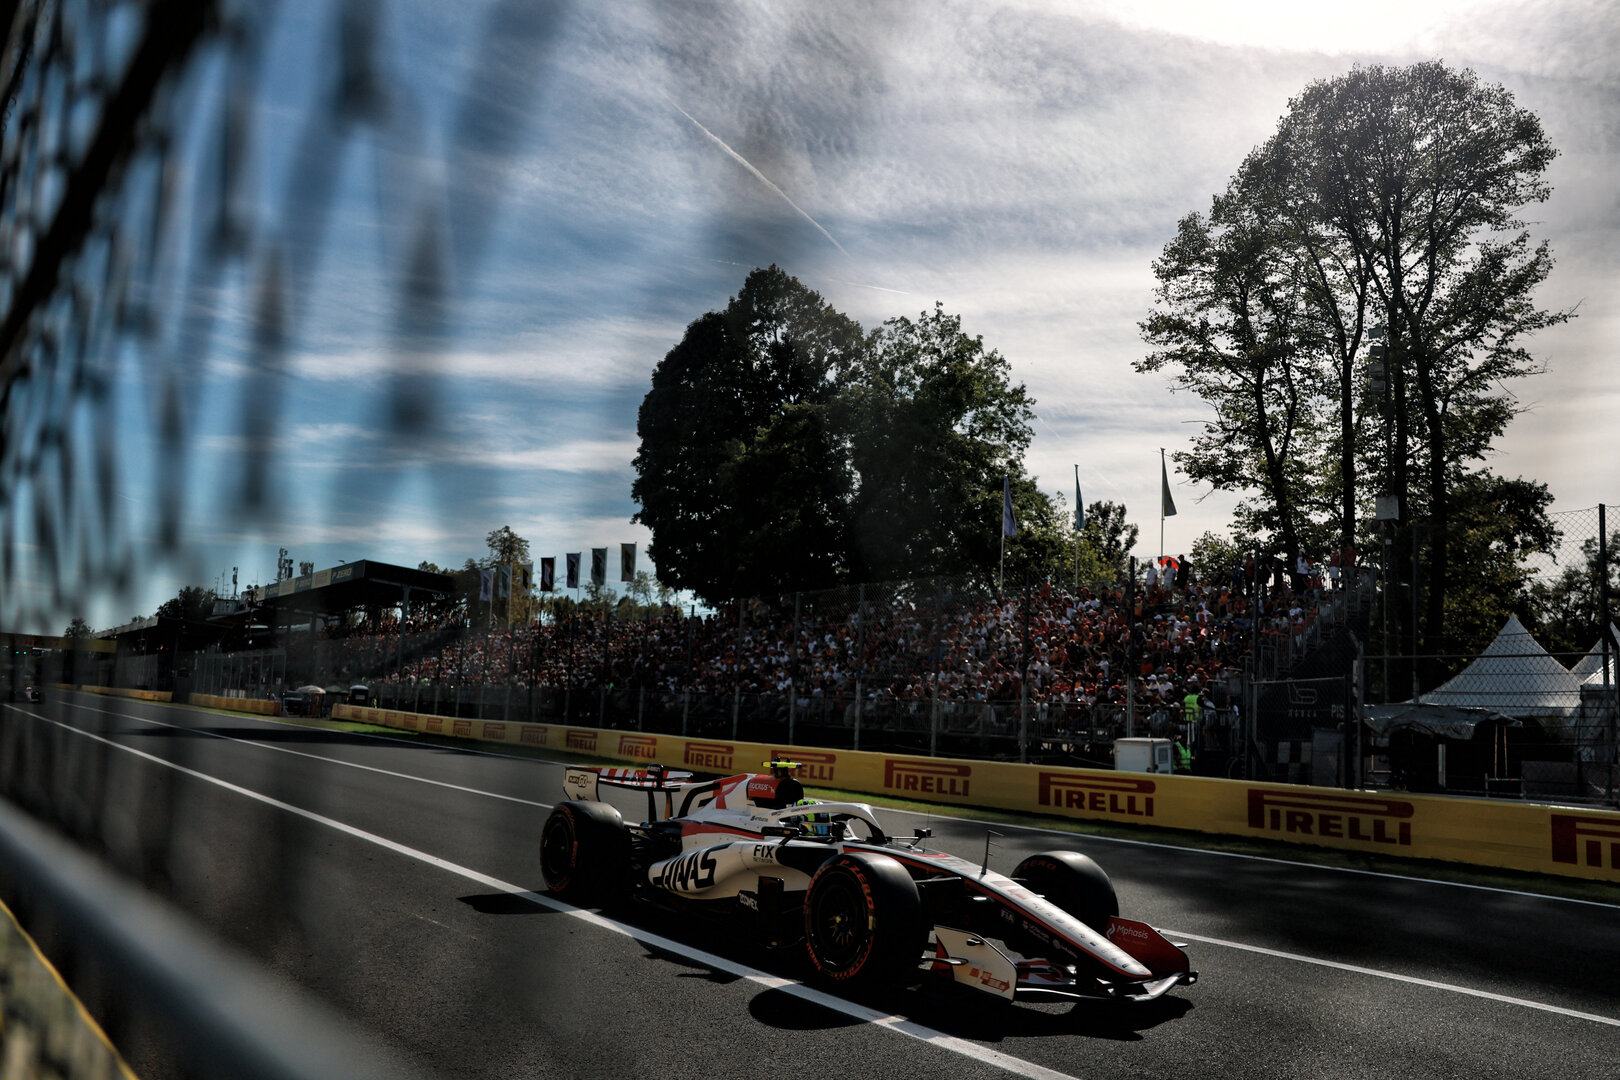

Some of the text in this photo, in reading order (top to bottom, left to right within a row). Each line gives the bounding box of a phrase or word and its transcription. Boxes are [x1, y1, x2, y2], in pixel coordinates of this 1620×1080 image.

[565, 729, 598, 752] PIRELLI
[618, 735, 657, 759] PIRELLI
[684, 742, 734, 770] PIRELLI
[770, 750, 836, 781] PELLI
[884, 758, 972, 797] PIRELLI
[1038, 771, 1157, 817] PIRELLI
[1247, 788, 1415, 846] PIRELLI
[753, 844, 775, 859] FIX
[1551, 813, 1620, 870] PI
[1117, 925, 1149, 939] Mphasis
